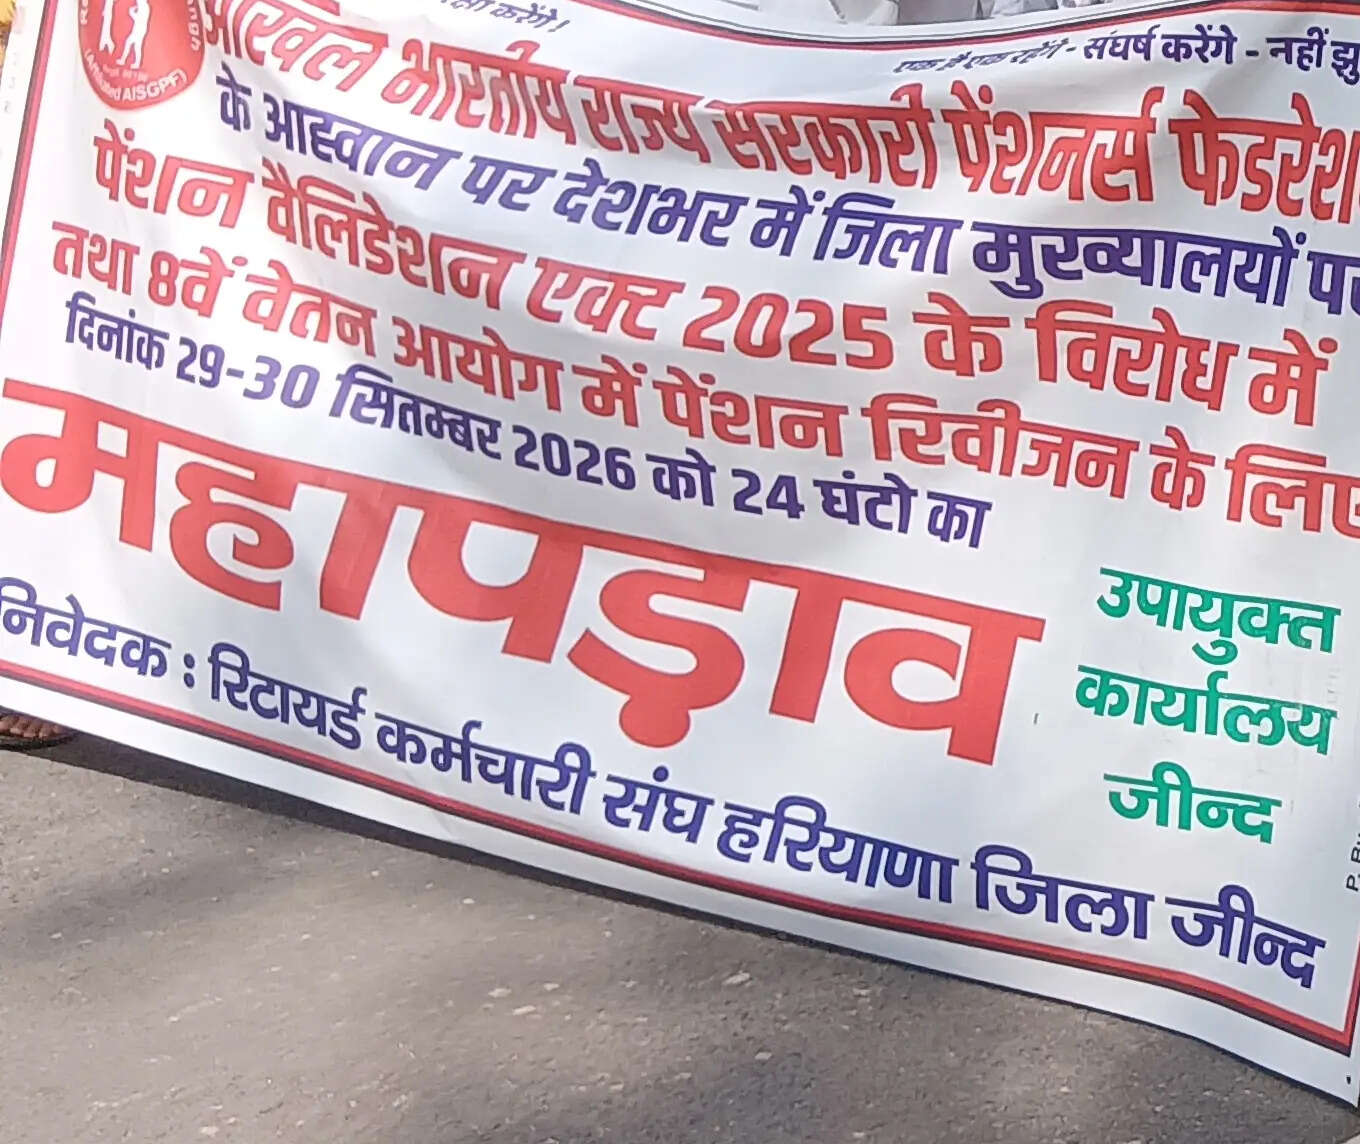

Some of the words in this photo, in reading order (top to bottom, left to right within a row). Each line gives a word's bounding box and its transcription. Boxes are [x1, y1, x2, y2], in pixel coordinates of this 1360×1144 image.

[381, 39, 577, 145] भारतीय
[574, 77, 711, 164] राज्य
[708, 83, 938, 189] सरकारी
[941, 80, 1165, 203] पेंशनर्स
[1083, 24, 1160, 61] संघर्ष
[1161, 24, 1238, 64] करेंगे
[1266, 27, 1329, 72] नहीं
[94, 119, 255, 228] पेंशन
[261, 158, 526, 310] वैलिडेशन
[526, 258, 685, 341] एक्ट
[682, 286, 894, 371] 2025
[912, 291, 1010, 378] के
[1024, 299, 1240, 412] विरोध
[1247, 328, 1338, 427] में
[216, 61, 251, 131] के
[462, 156, 557, 212] पर
[554, 158, 750, 247] देशभर
[750, 185, 823, 257] में
[814, 192, 964, 275] जिला
[972, 222, 1307, 307] मुख्यालयों
[52, 220, 140, 295] तथा
[148, 246, 250, 319] 8वें
[241, 259, 377, 357] वेतन
[393, 317, 565, 412] आयोग
[572, 354, 648, 428] में
[652, 366, 849, 458] पेंशन
[860, 393, 1140, 499] रिवीजन
[1149, 426, 1216, 511] के
[66, 291, 169, 371] दिनांक
[176, 339, 319, 408] 29-30
[328, 364, 503, 461] सितम्बर
[513, 425, 637, 491] 2026
[646, 448, 718, 508] को
[731, 469, 805, 520] 24
[812, 470, 918, 534] घंटो
[927, 490, 993, 549] का
[0, 378, 1046, 766] महापड़ाव
[1097, 568, 1342, 666] उपायुक्त
[0, 577, 171, 678] निवेदक
[208, 642, 367, 751] रिटायर्ड
[375, 716, 597, 816] कर्मचारी
[602, 766, 715, 843] संघ
[717, 795, 960, 904] हरियाणा
[970, 844, 1156, 940] जिला
[1165, 884, 1327, 989] जीन्द
[1075, 666, 1338, 756] कार्यालय
[1103, 761, 1282, 845] जीन्द
[1346, 872, 1360, 892] P.
